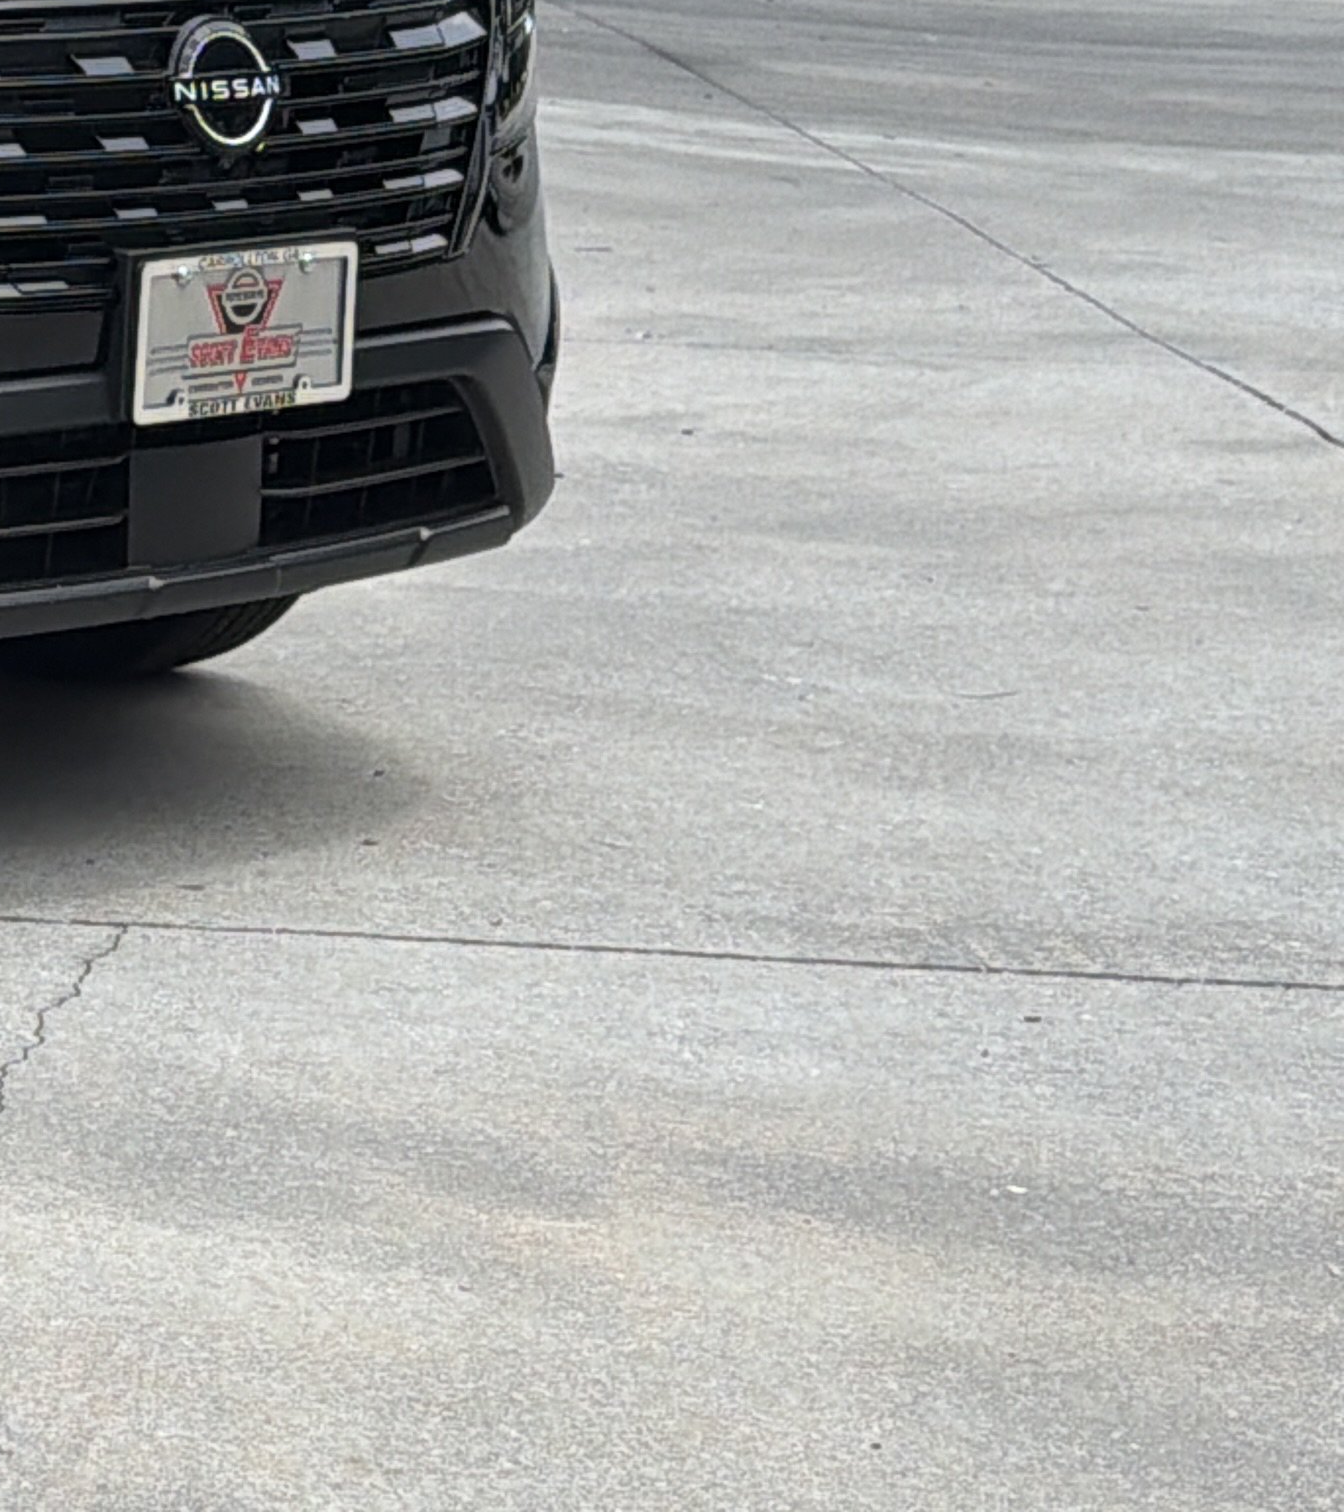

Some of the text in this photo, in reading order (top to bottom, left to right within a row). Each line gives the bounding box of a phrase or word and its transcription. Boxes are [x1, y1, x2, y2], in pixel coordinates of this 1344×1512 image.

[173, 73, 281, 102] NISSAN
[188, 391, 297, 417] SCOTT EVANS
